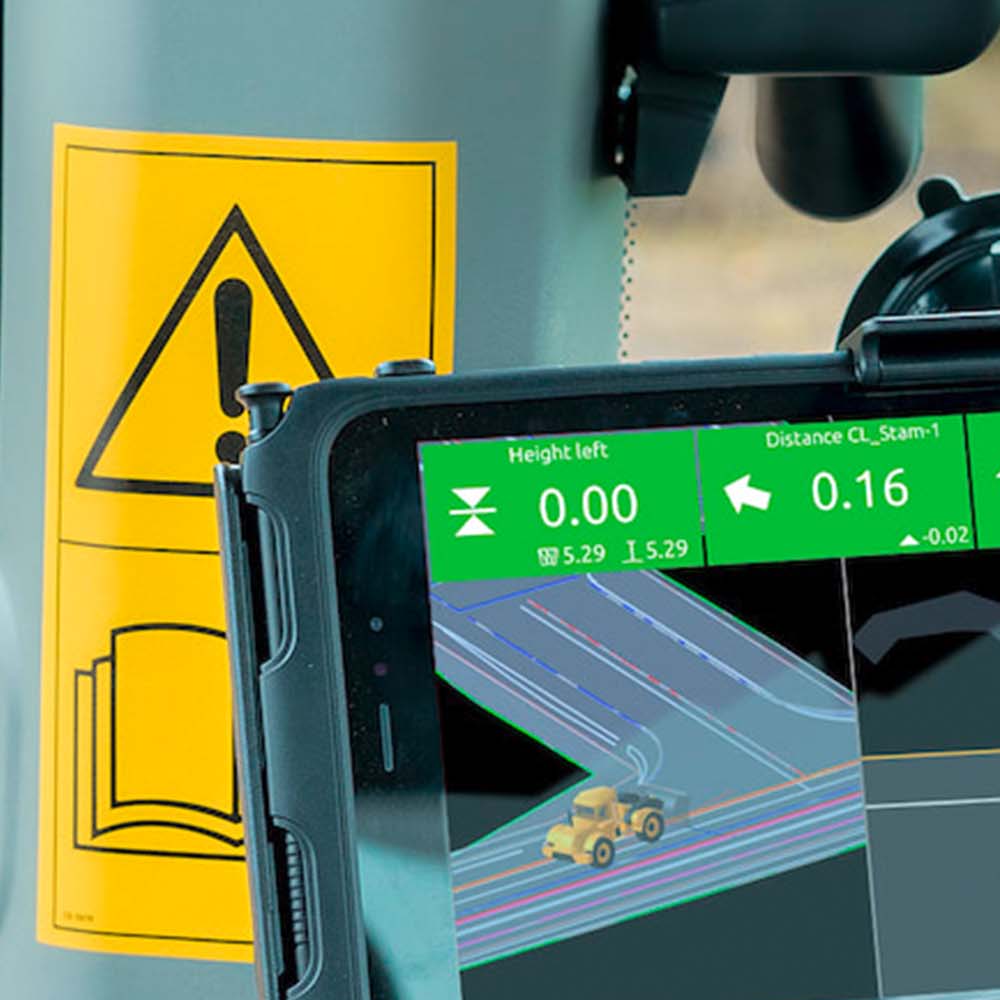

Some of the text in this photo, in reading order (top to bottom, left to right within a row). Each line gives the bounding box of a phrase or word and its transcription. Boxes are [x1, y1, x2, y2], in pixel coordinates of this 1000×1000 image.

[765, 422, 941, 449] Distance CL_Stam-1
[508, 441, 608, 465] Height left
[811, 467, 909, 512] 0.16
[539, 483, 638, 528] 0.00
[922, 526, 970, 545] -0.02
[563, 544, 606, 564] 5.29
[646, 539, 688, 560] 5.29
